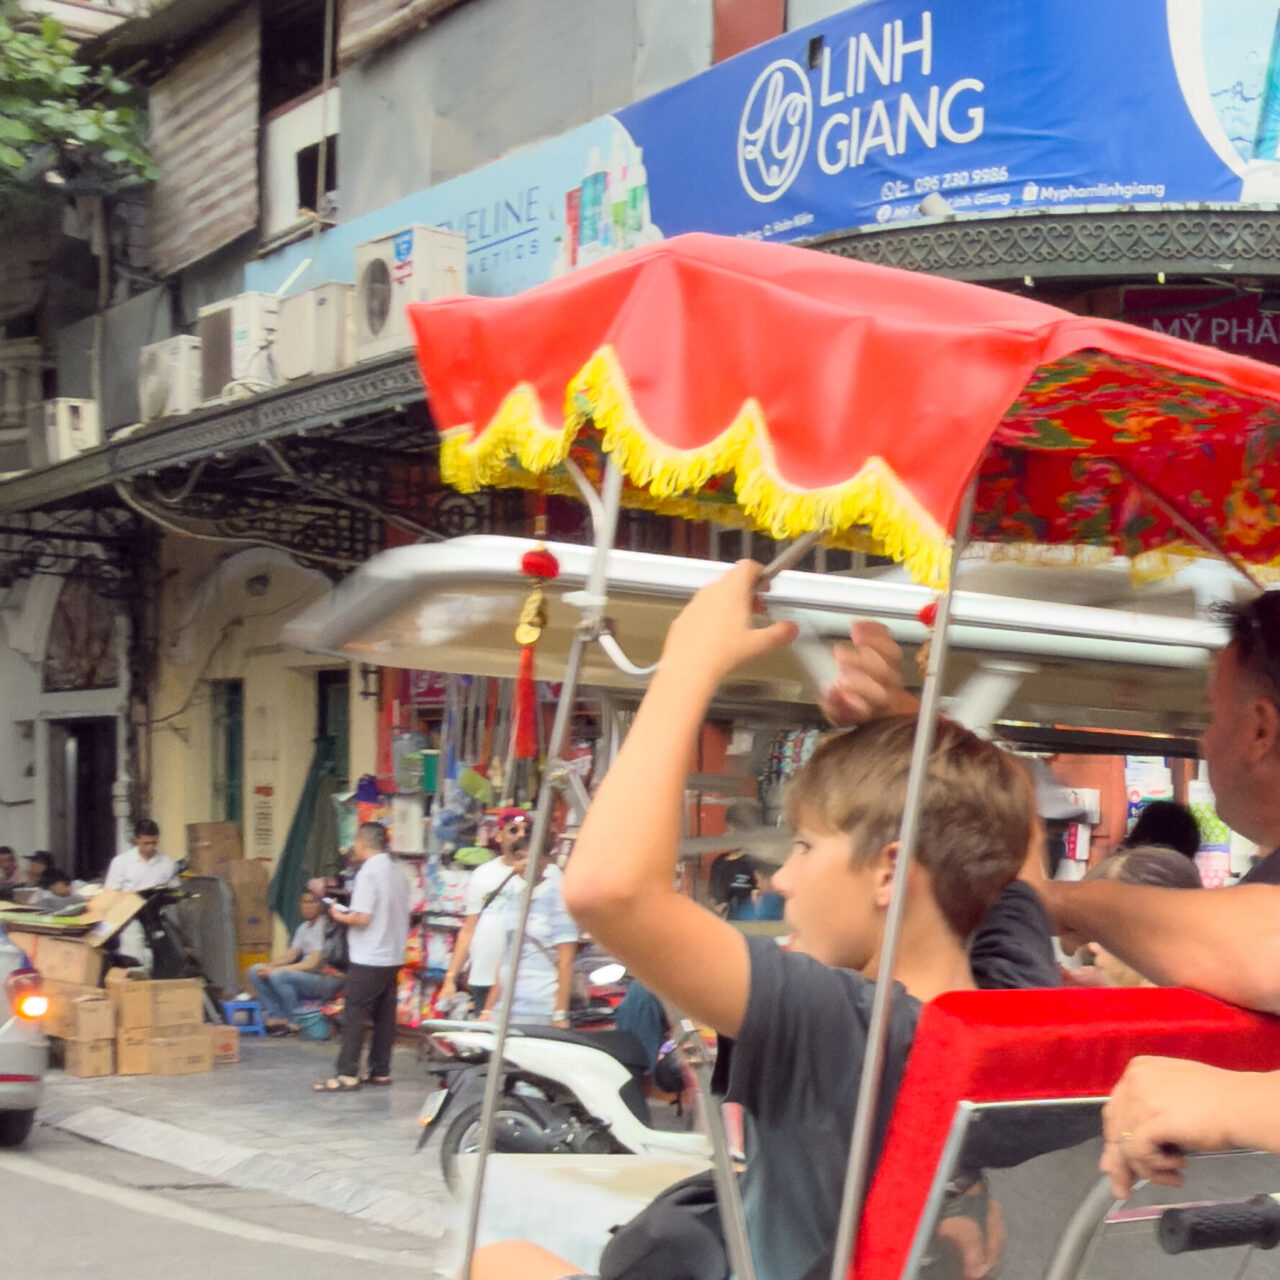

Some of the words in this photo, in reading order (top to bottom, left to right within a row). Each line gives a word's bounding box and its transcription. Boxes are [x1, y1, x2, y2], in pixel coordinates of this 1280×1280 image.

[820, 11, 932, 107] LINH
[817, 78, 985, 175] GIANG
[942, 171, 969, 189] 230
[1152, 313, 1203, 342] MỸ
